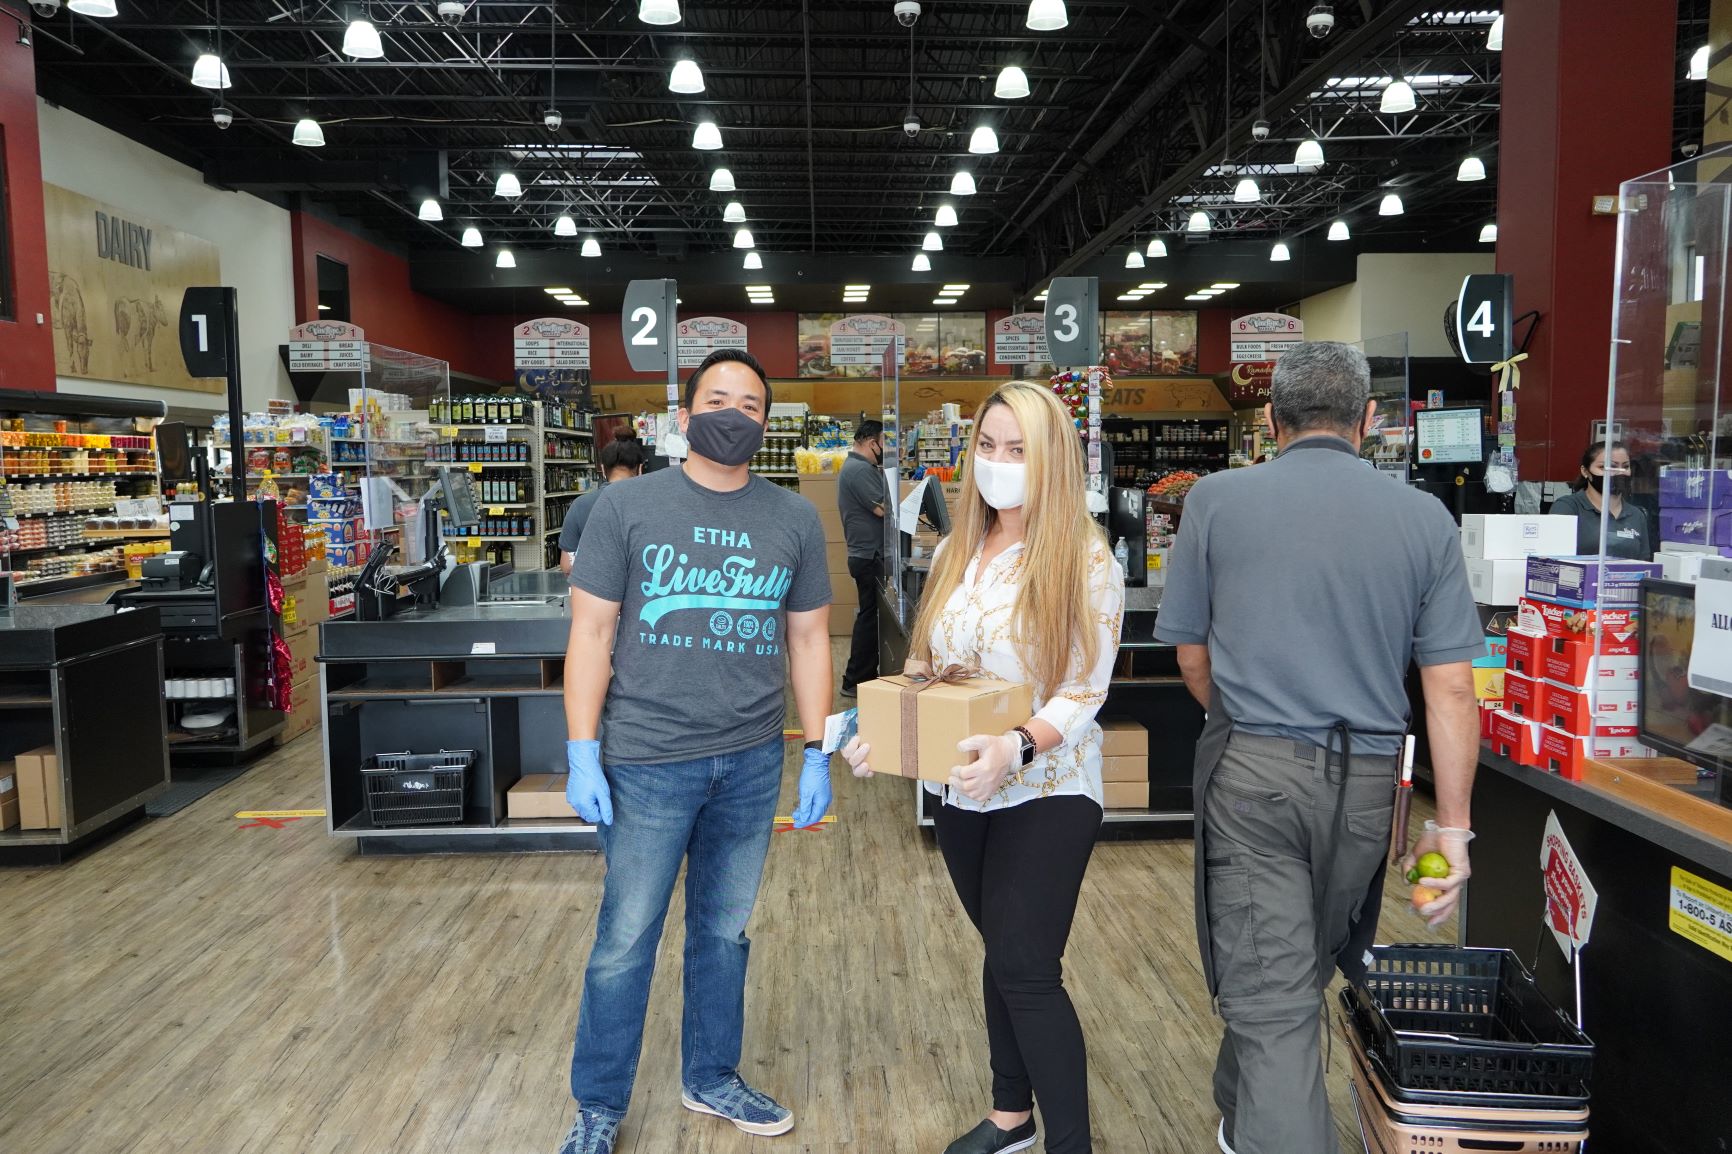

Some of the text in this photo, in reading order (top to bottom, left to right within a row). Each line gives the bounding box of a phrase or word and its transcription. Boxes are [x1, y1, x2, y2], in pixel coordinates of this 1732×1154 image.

[96, 210, 152, 271] DAIRY
[631, 306, 658, 345] 2
[681, 325, 688, 335] 3
[731, 325, 738, 334] 3
[1004, 321, 1011, 331] 5
[1053, 303, 1080, 342] 3
[1240, 321, 1247, 331] 6
[1288, 320, 1295, 330] 6
[1466, 300, 1495, 338] 4
[191, 314, 208, 351] 1
[523, 326, 530, 336] 2
[573, 326, 581, 336] 2
[1101, 388, 1146, 406] EATS
[693, 526, 752, 549] ETHA
[640, 632, 779, 656] TRADE MARK USA
[1546, 835, 1569, 863] SHOPPING
[1568, 859, 1588, 920] BASKETS
[1678, 899, 1716, 926] 1-800-5
